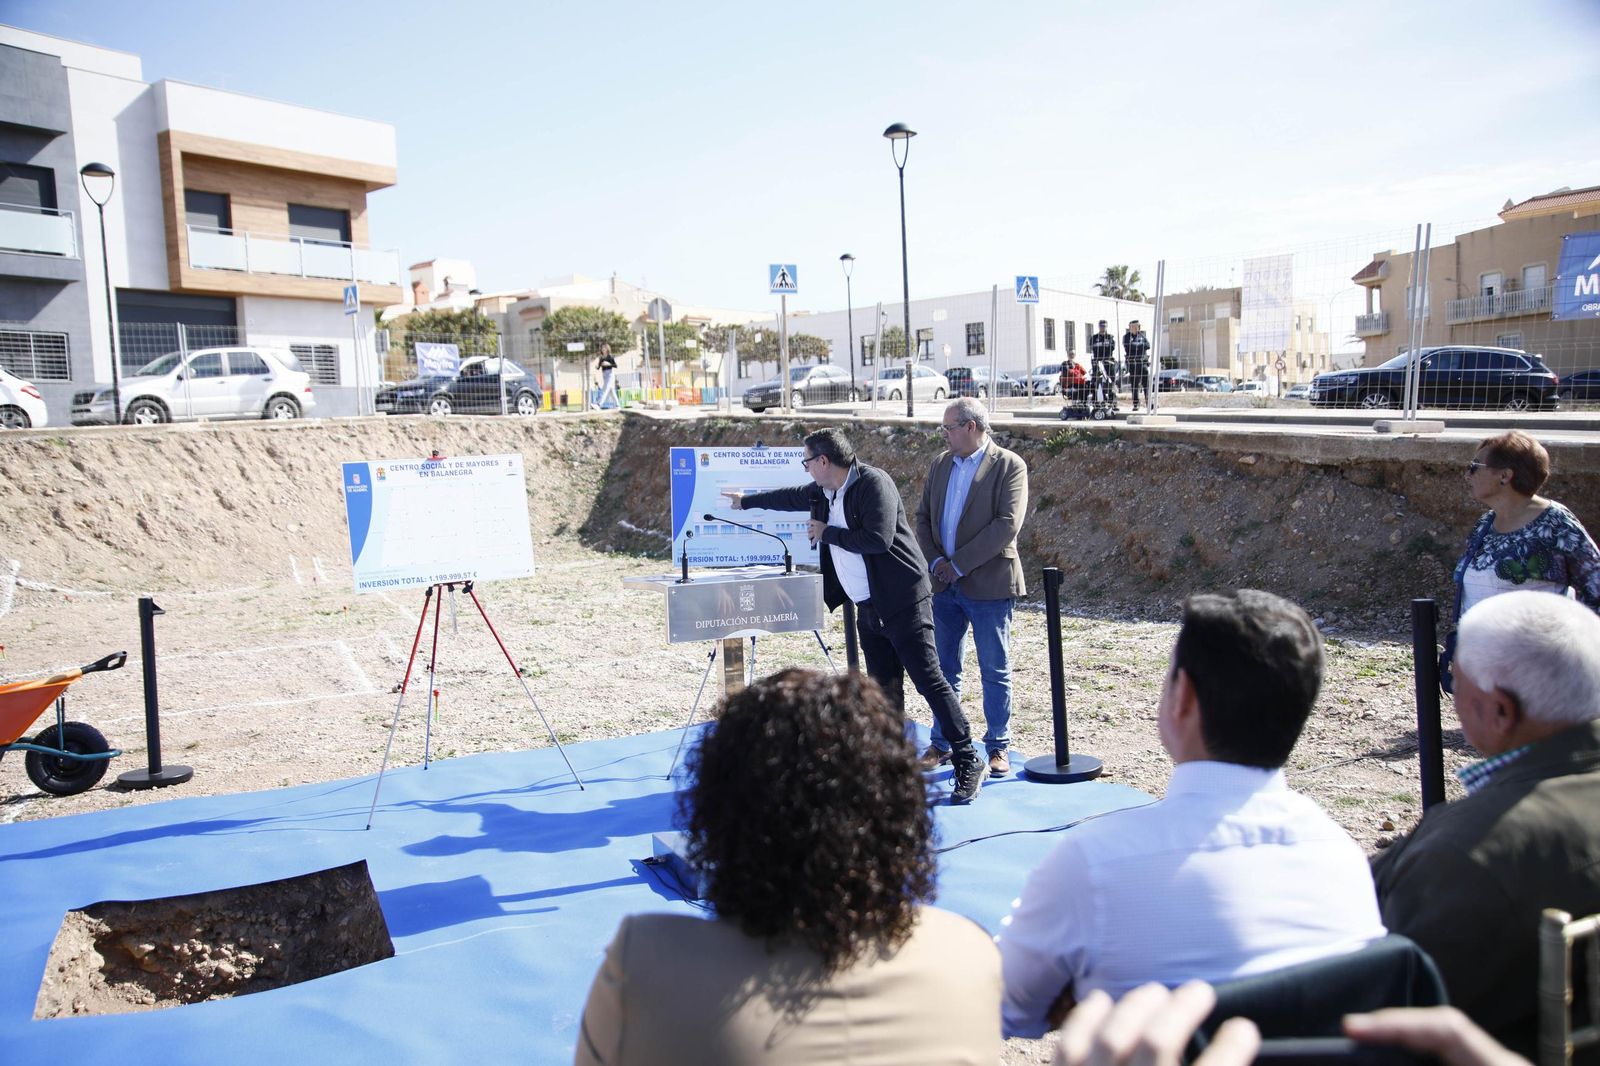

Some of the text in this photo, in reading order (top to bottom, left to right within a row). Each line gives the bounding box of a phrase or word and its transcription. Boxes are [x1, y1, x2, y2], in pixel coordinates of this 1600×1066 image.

[423, 358, 455, 371] Mayfra
[390, 462, 420, 472] CENTRO
[420, 461, 447, 470] SOCIAL
[466, 459, 499, 468] MAYORES
[419, 469, 473, 478] EN BALANEGRA
[741, 554, 780, 562] 1.199.999,57
[401, 576, 427, 585] TOTAL:
[429, 571, 472, 582] 1.199.999,57
[695, 611, 799, 629] DIPUTACIÓN DE ALMERÍA
